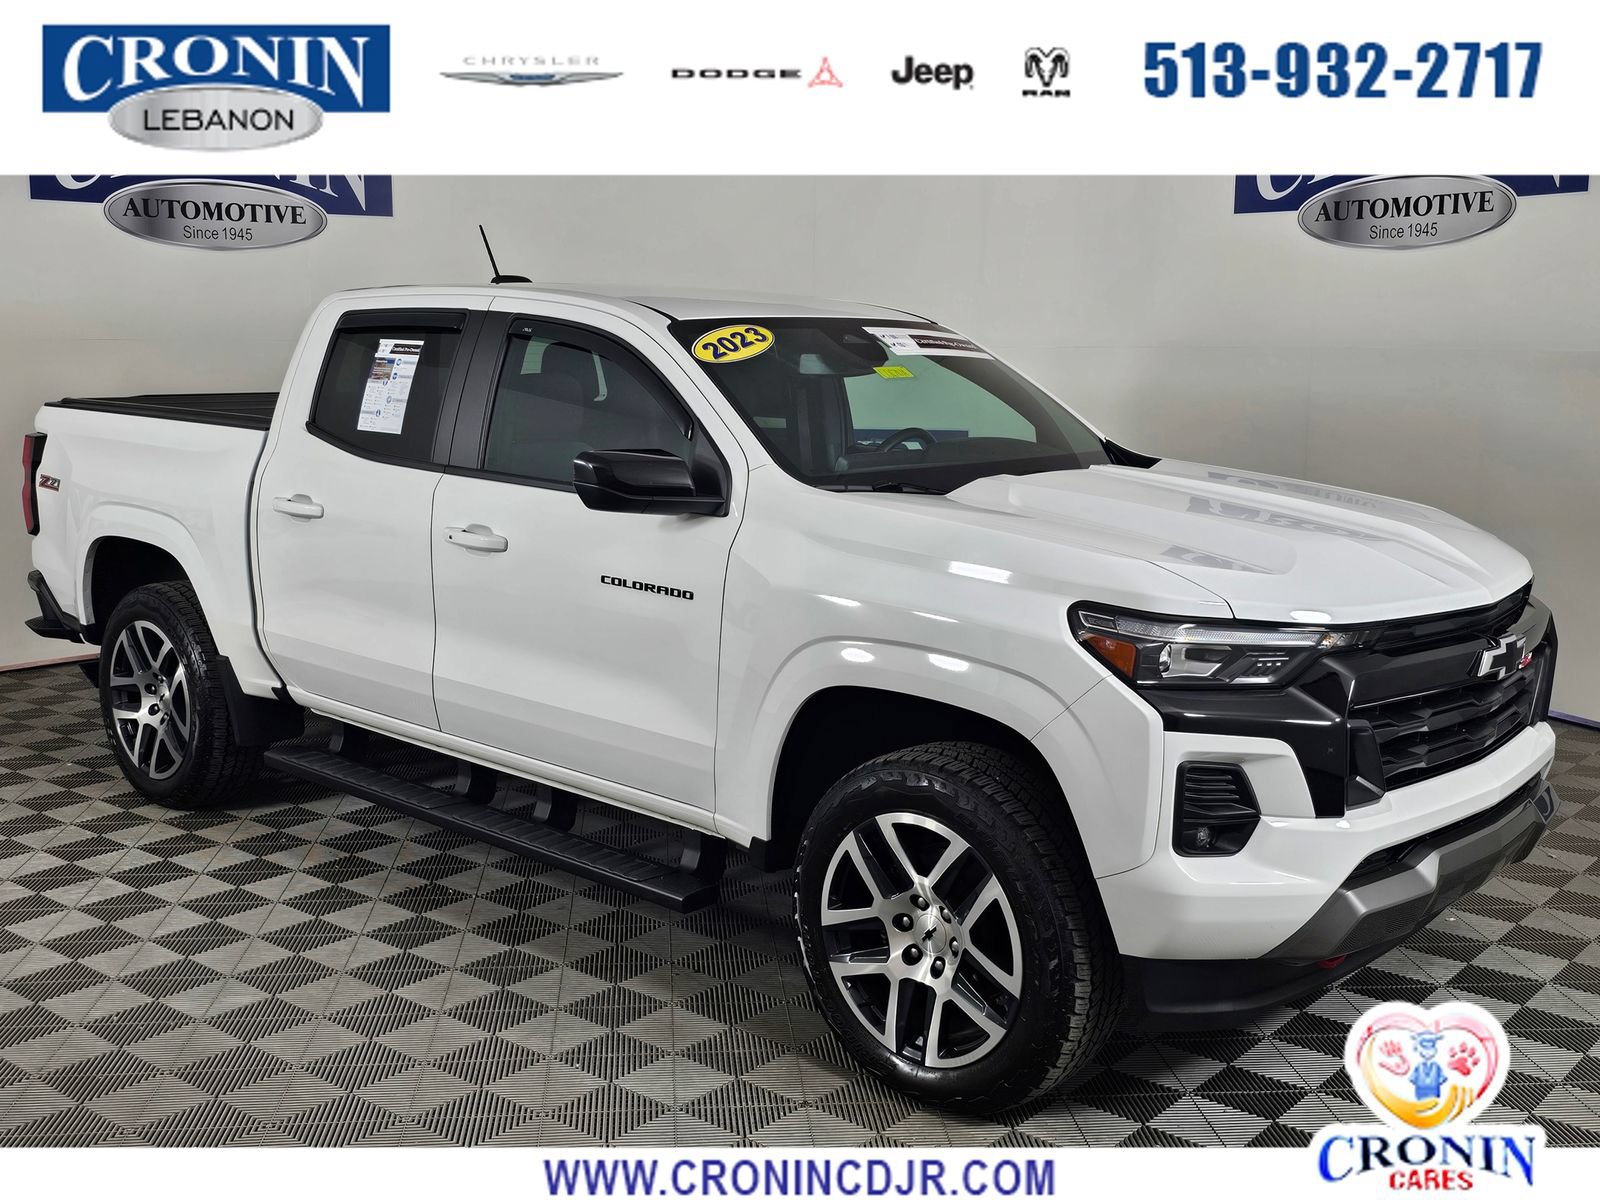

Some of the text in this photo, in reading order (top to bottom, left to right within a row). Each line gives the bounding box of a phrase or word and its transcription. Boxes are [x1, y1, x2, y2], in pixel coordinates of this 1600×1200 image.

[122, 197, 307, 225] AUTOMOTIVE
[1314, 190, 1495, 223] AUTOMOTIVE
[183, 224, 253, 242] Since 1945
[1369, 222, 1439, 240] Since 1945
[701, 327, 768, 360] 2023
[600, 575, 694, 601] COLORADO
